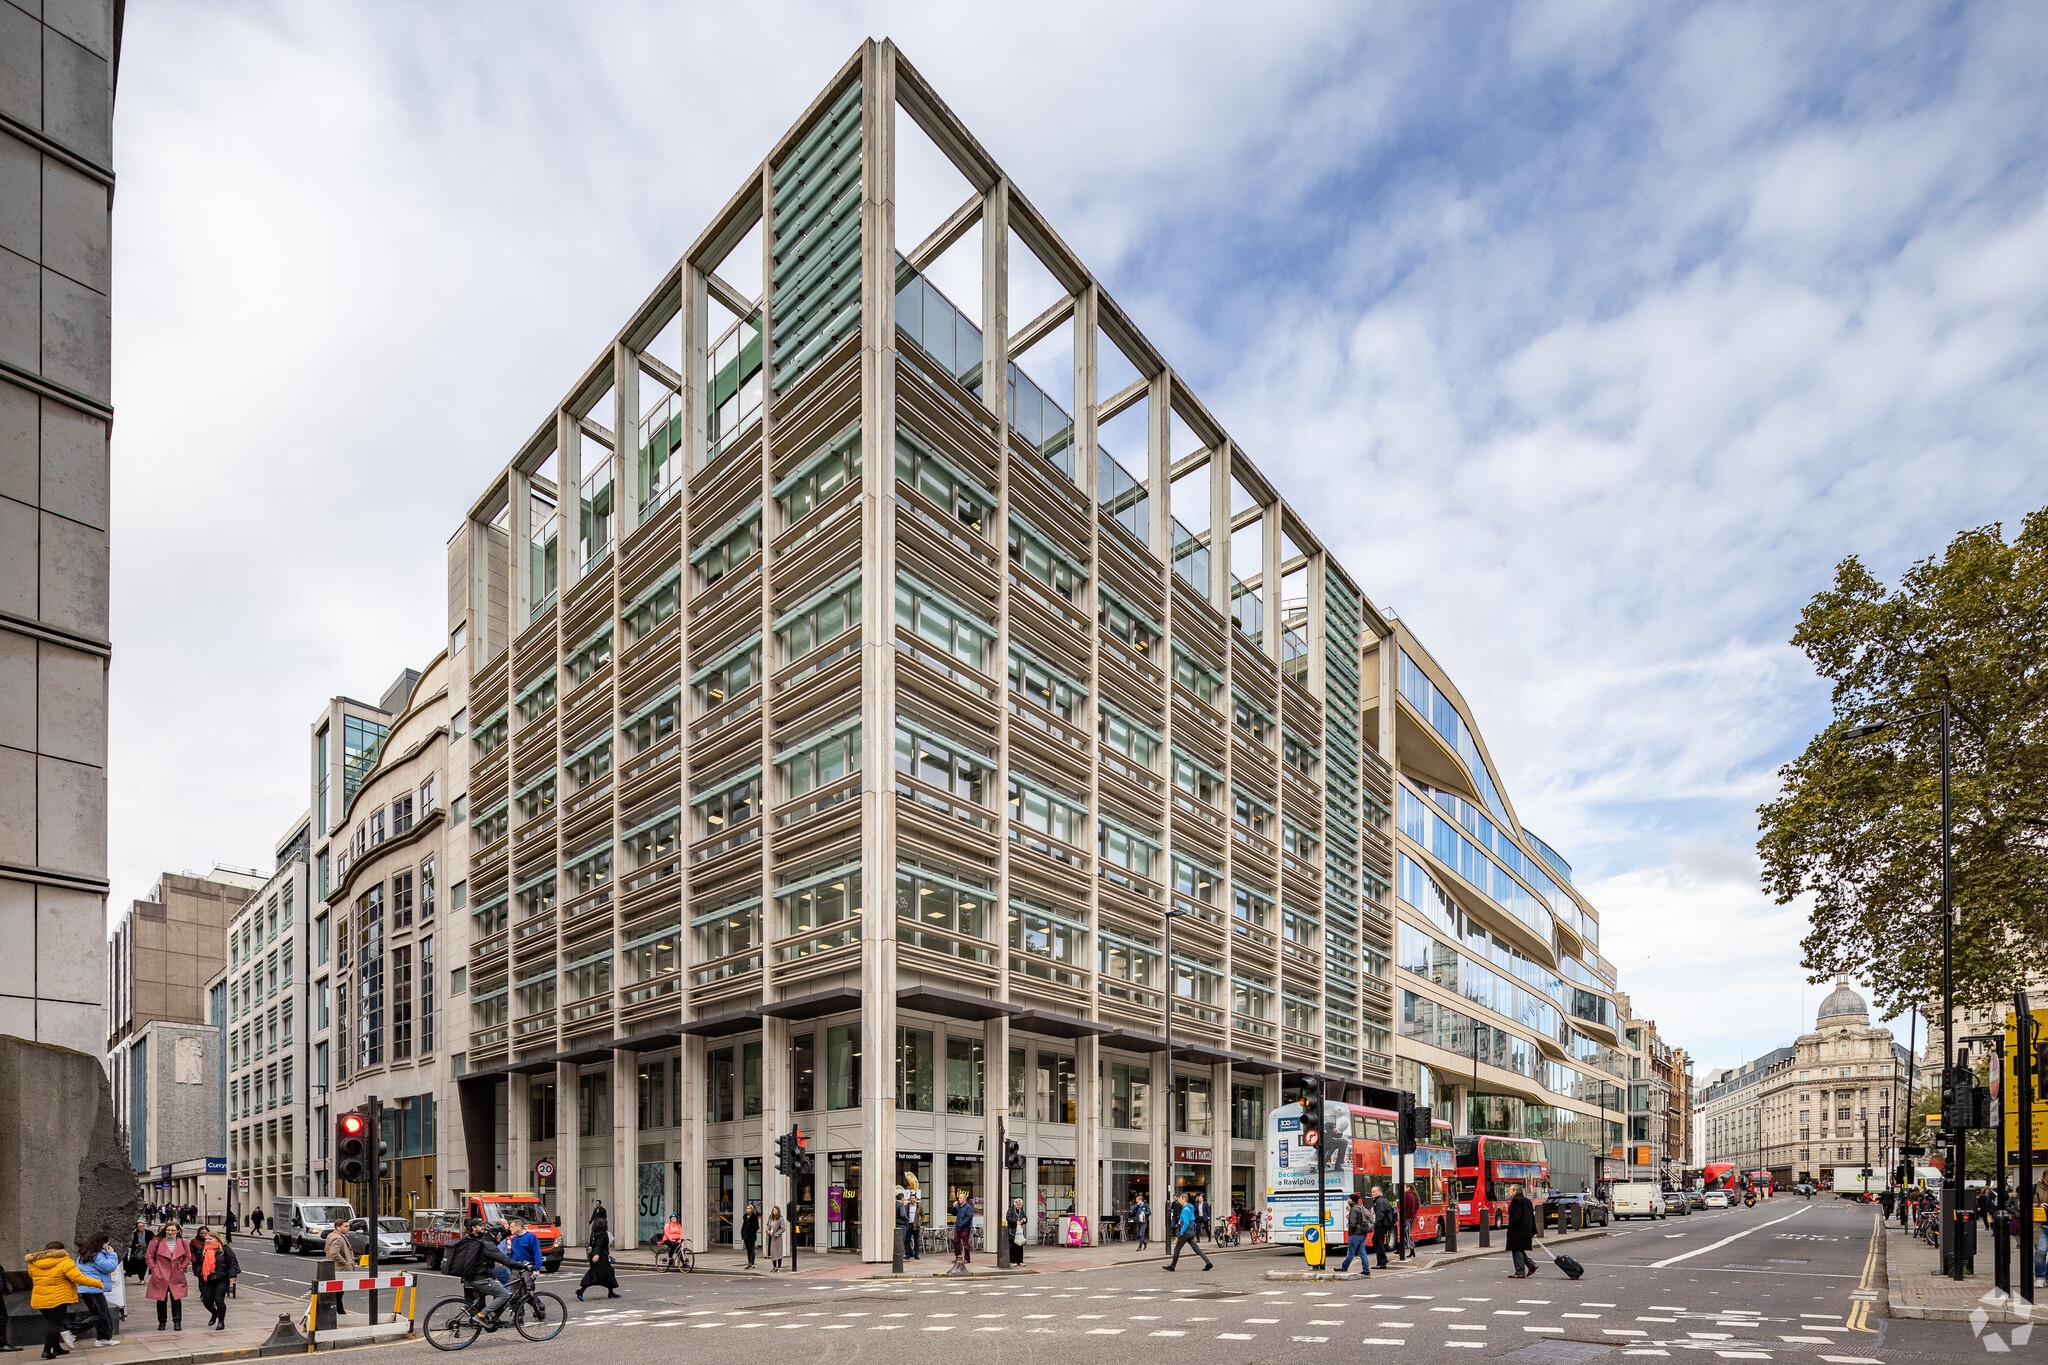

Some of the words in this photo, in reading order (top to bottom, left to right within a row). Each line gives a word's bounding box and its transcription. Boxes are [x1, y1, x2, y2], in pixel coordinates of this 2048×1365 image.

[540, 1165, 551, 1173] 20
[1283, 1178, 1315, 1186] Rawlplug
[842, 1188, 856, 1199] itsu
